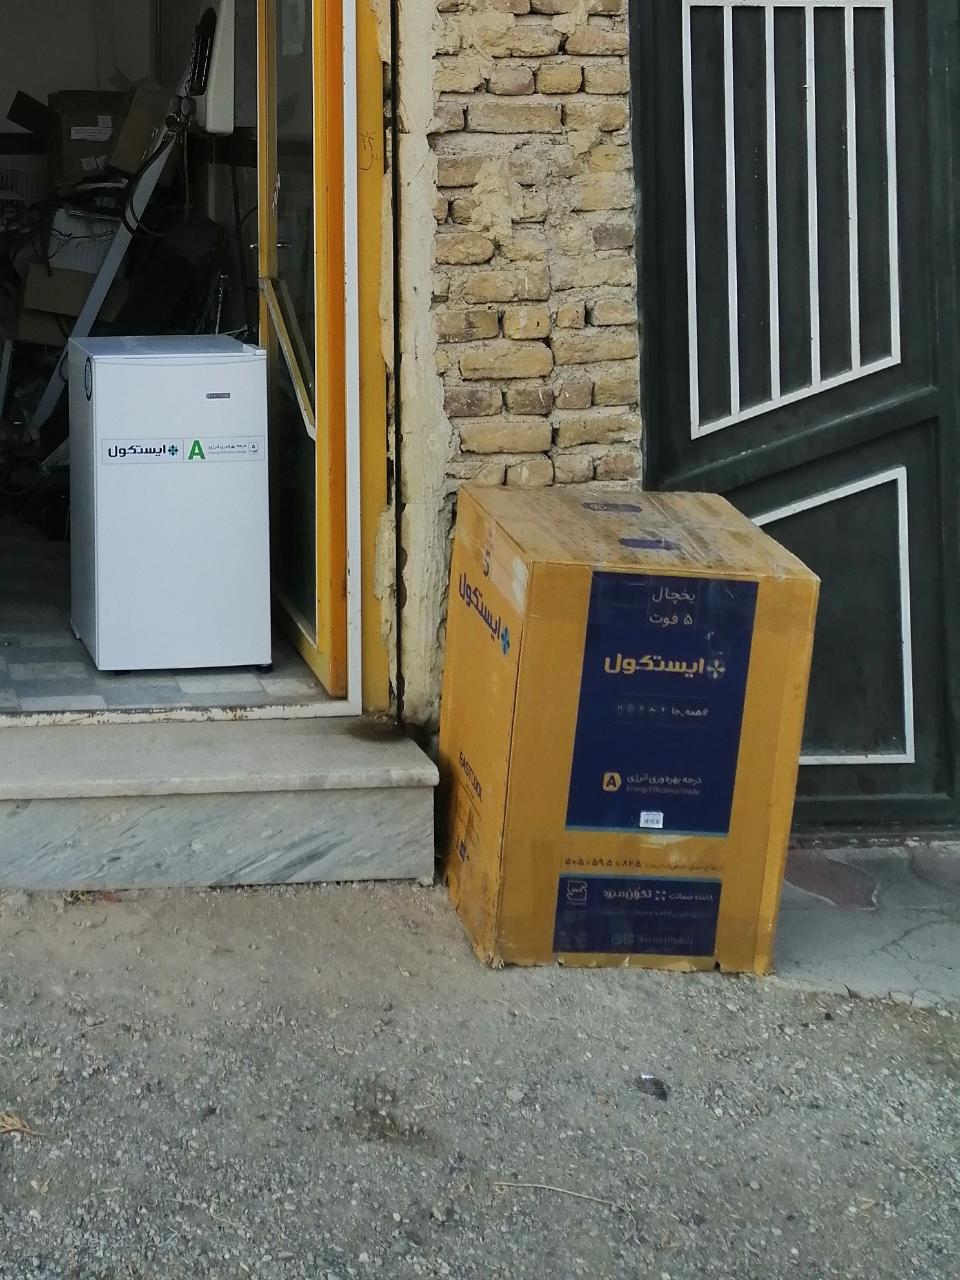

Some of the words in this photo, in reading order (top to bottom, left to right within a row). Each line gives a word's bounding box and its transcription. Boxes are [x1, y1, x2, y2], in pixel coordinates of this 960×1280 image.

[108, 444, 166, 458] ایستکول
[188, 439, 206, 460] A
[652, 587, 696, 605] یخچال
[459, 572, 502, 642] ایستکول
[649, 612, 679, 628] فوت
[683, 614, 693, 625] ۵
[604, 652, 705, 678] ایستکول
[606, 775, 617, 788] A
